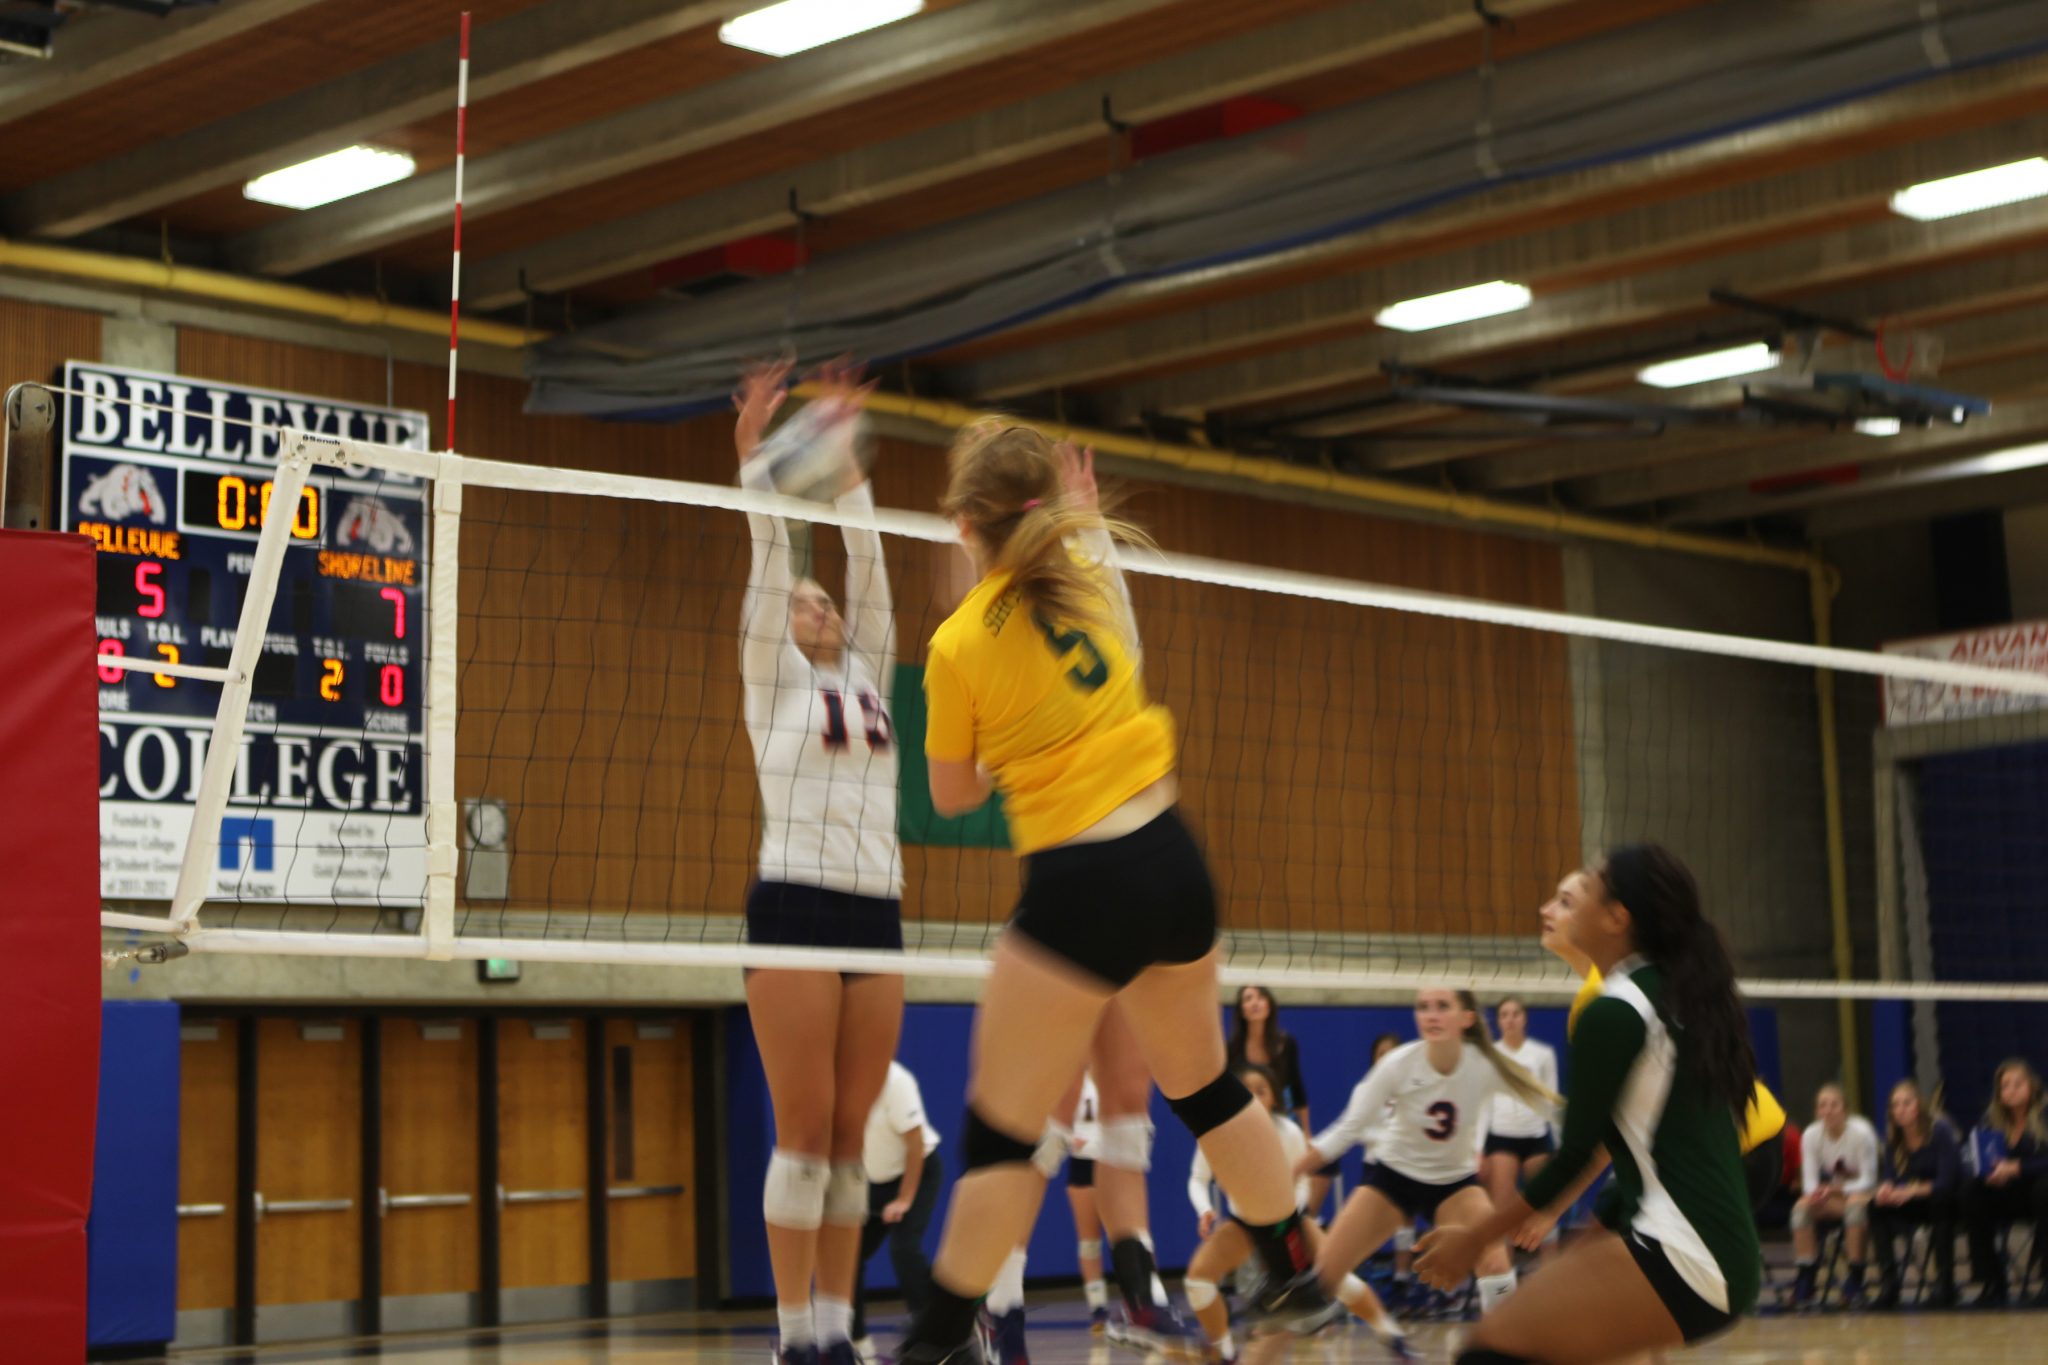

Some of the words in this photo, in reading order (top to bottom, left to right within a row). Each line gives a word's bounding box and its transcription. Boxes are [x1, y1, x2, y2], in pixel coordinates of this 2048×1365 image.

[135, 561, 165, 618] 5
[318, 550, 416, 586] SHORELINE
[379, 586, 406, 640] 7
[153, 642, 180, 689] 2
[319, 657, 344, 703] 2
[379, 663, 404, 707] 0
[1424, 1100, 1458, 1142] 3
